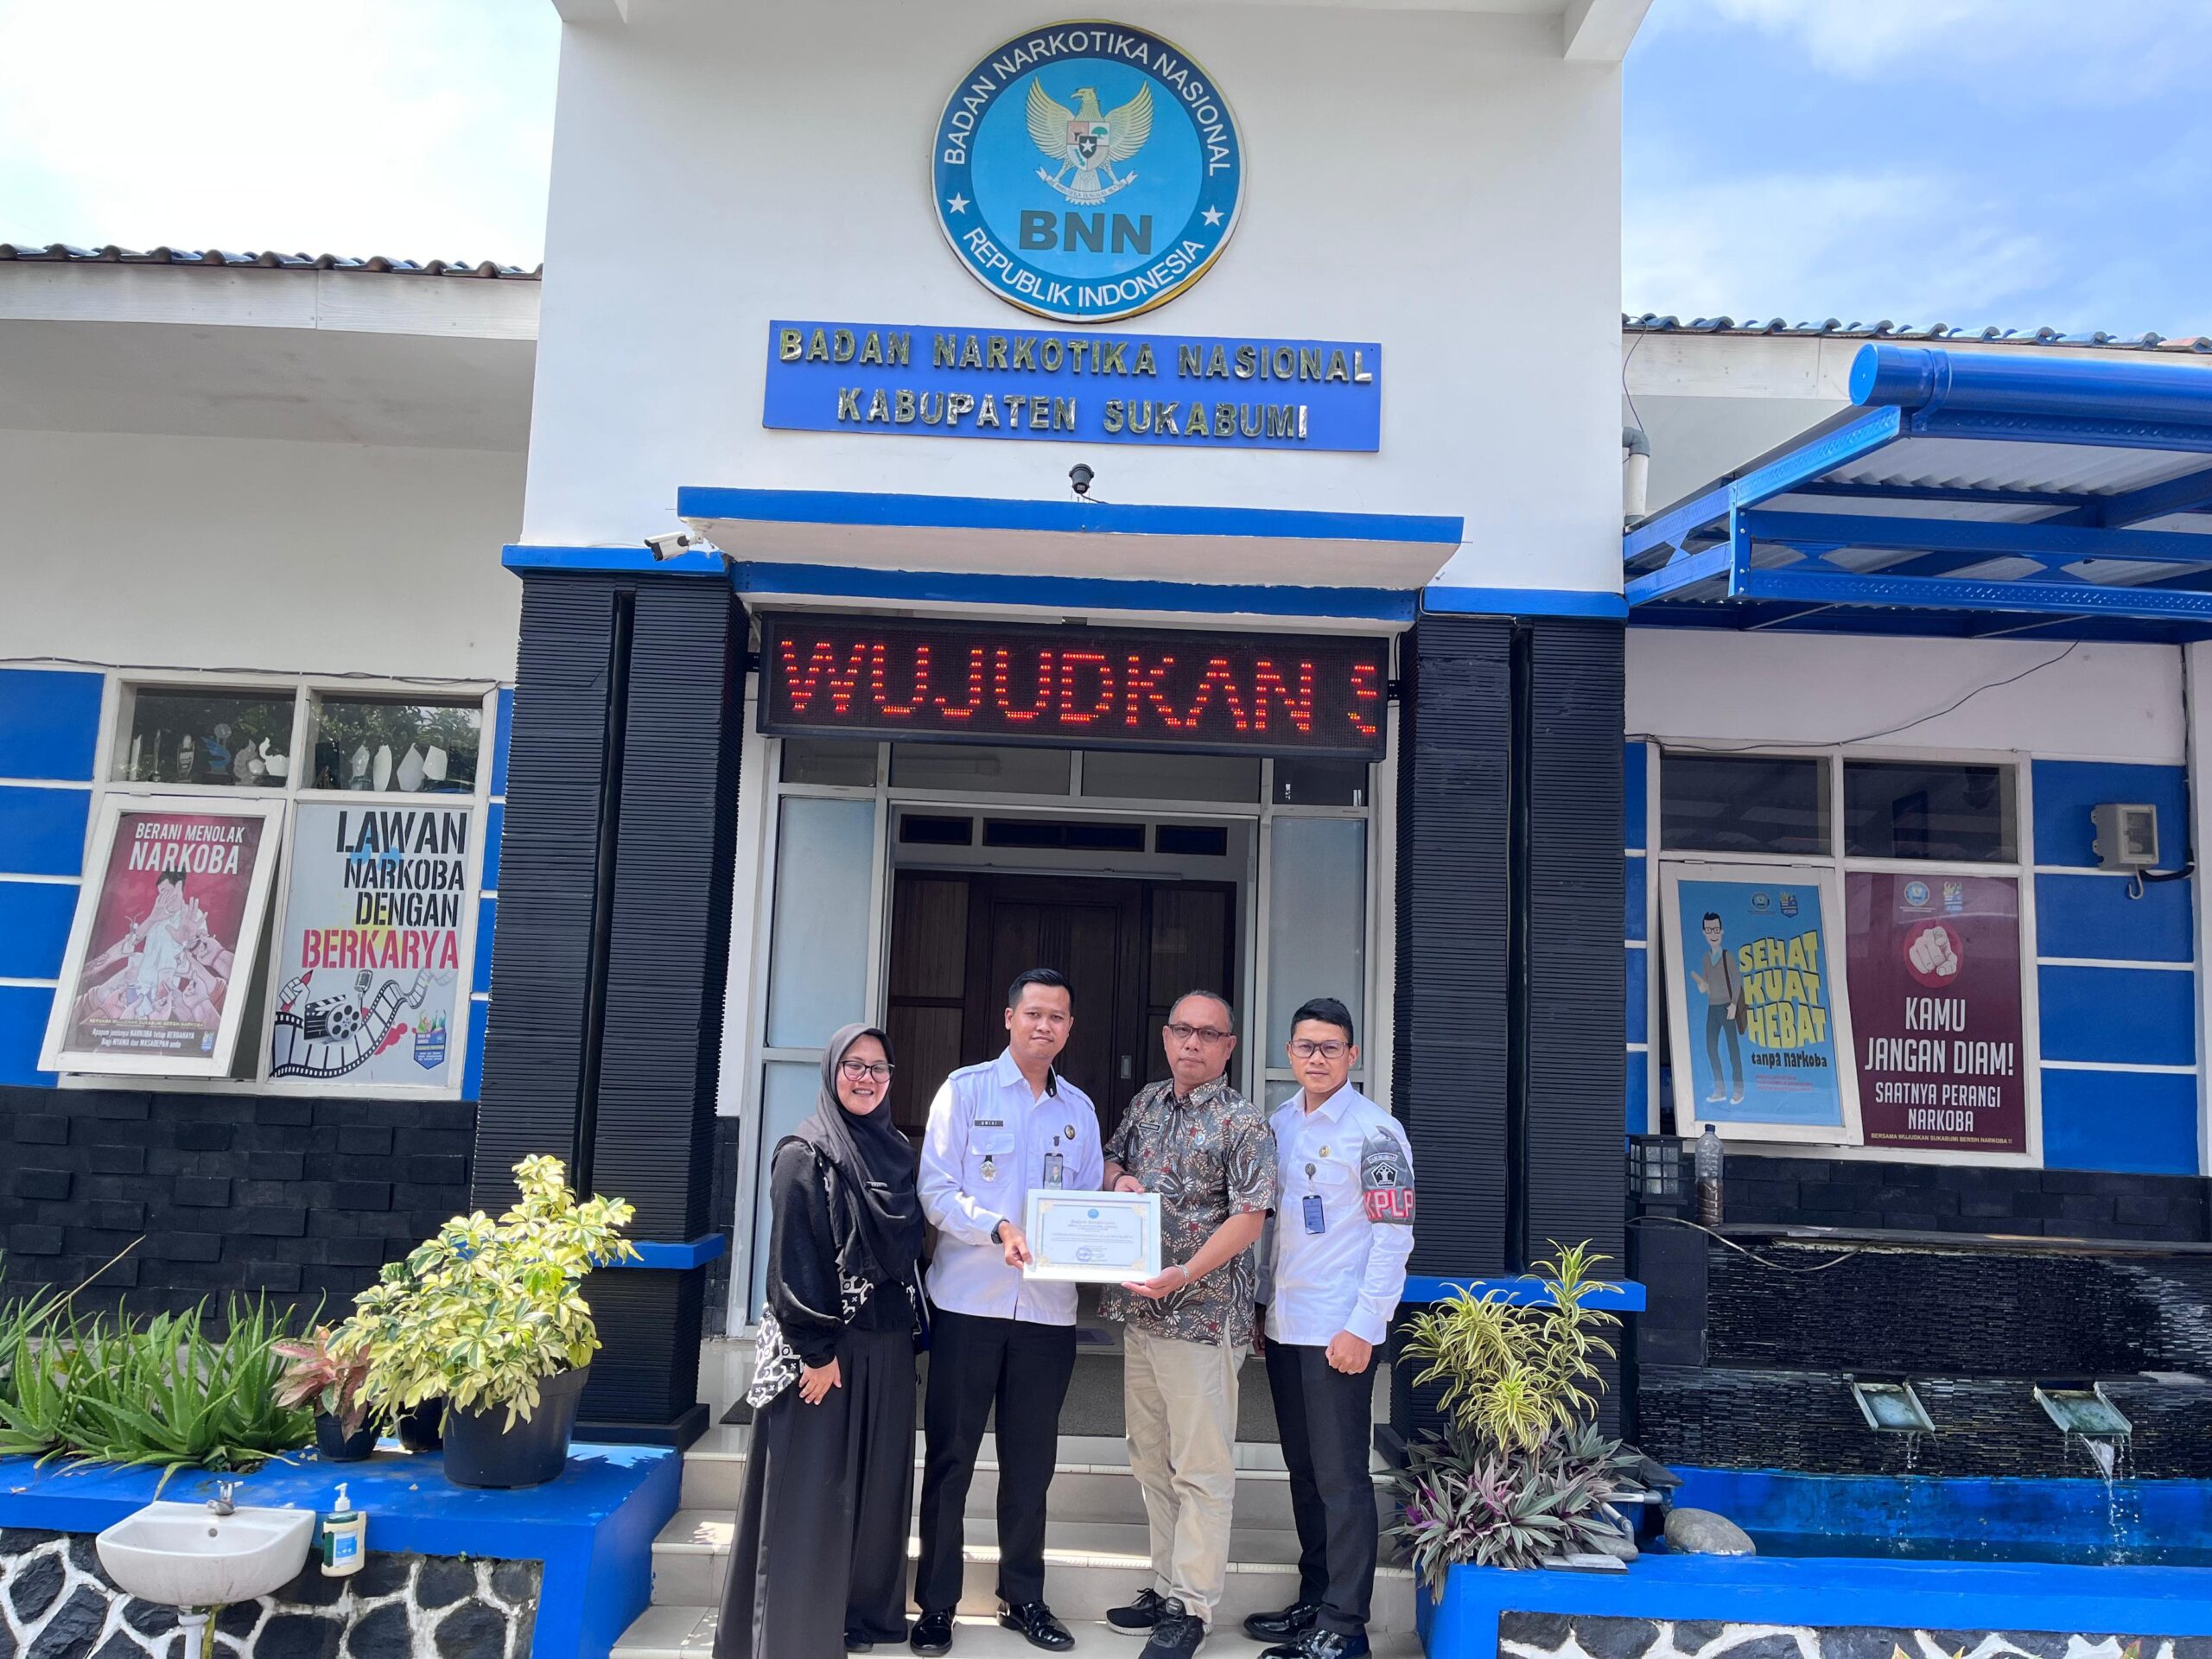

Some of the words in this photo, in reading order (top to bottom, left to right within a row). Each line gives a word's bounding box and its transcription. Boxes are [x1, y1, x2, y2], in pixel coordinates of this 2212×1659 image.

[944, 76, 996, 164] BADAN
[993, 31, 1148, 80] NARKOTIKA
[1153, 53, 1230, 176] NASIONAL
[1019, 210, 1153, 255] BNN
[963, 226, 1072, 306] REPUBLIK
[1078, 238, 1205, 308] INDONESIA
[779, 327, 911, 365] BADAN
[932, 334, 1157, 375] NARKOTIKA
[1178, 344, 1372, 382] NASIONAL
[836, 387, 1076, 431] KABUPATEN
[1103, 397, 1307, 438] SUKABUMI
[781, 640, 1312, 731] WUJUDKAN
[135, 823, 181, 841] BERANI
[184, 824, 245, 843] MENOLAK
[336, 810, 467, 855] LAWAN
[128, 842, 239, 874] NARKOBA
[344, 858, 465, 891] NARKOBA
[355, 892, 459, 927] DENGAN
[302, 929, 459, 969] BERKARYA
[1738, 929, 1818, 973] SEHAT
[1744, 967, 1821, 1006] KUAT
[1746, 1001, 1827, 1049] HEBAT
[1905, 997, 1966, 1032] KAMU
[1751, 1052, 1781, 1069] tanpa
[1784, 1052, 1827, 1068] narkoba
[1865, 1037, 1945, 1073] JANGAN
[1953, 1041, 2014, 1076] DIAM!
[1875, 1082, 1937, 1105] SAATNYA
[1942, 1084, 2000, 1108] PERANGI
[1908, 1109, 1974, 1132] NARKOBA
[1363, 1188, 1413, 1219] KPLP
